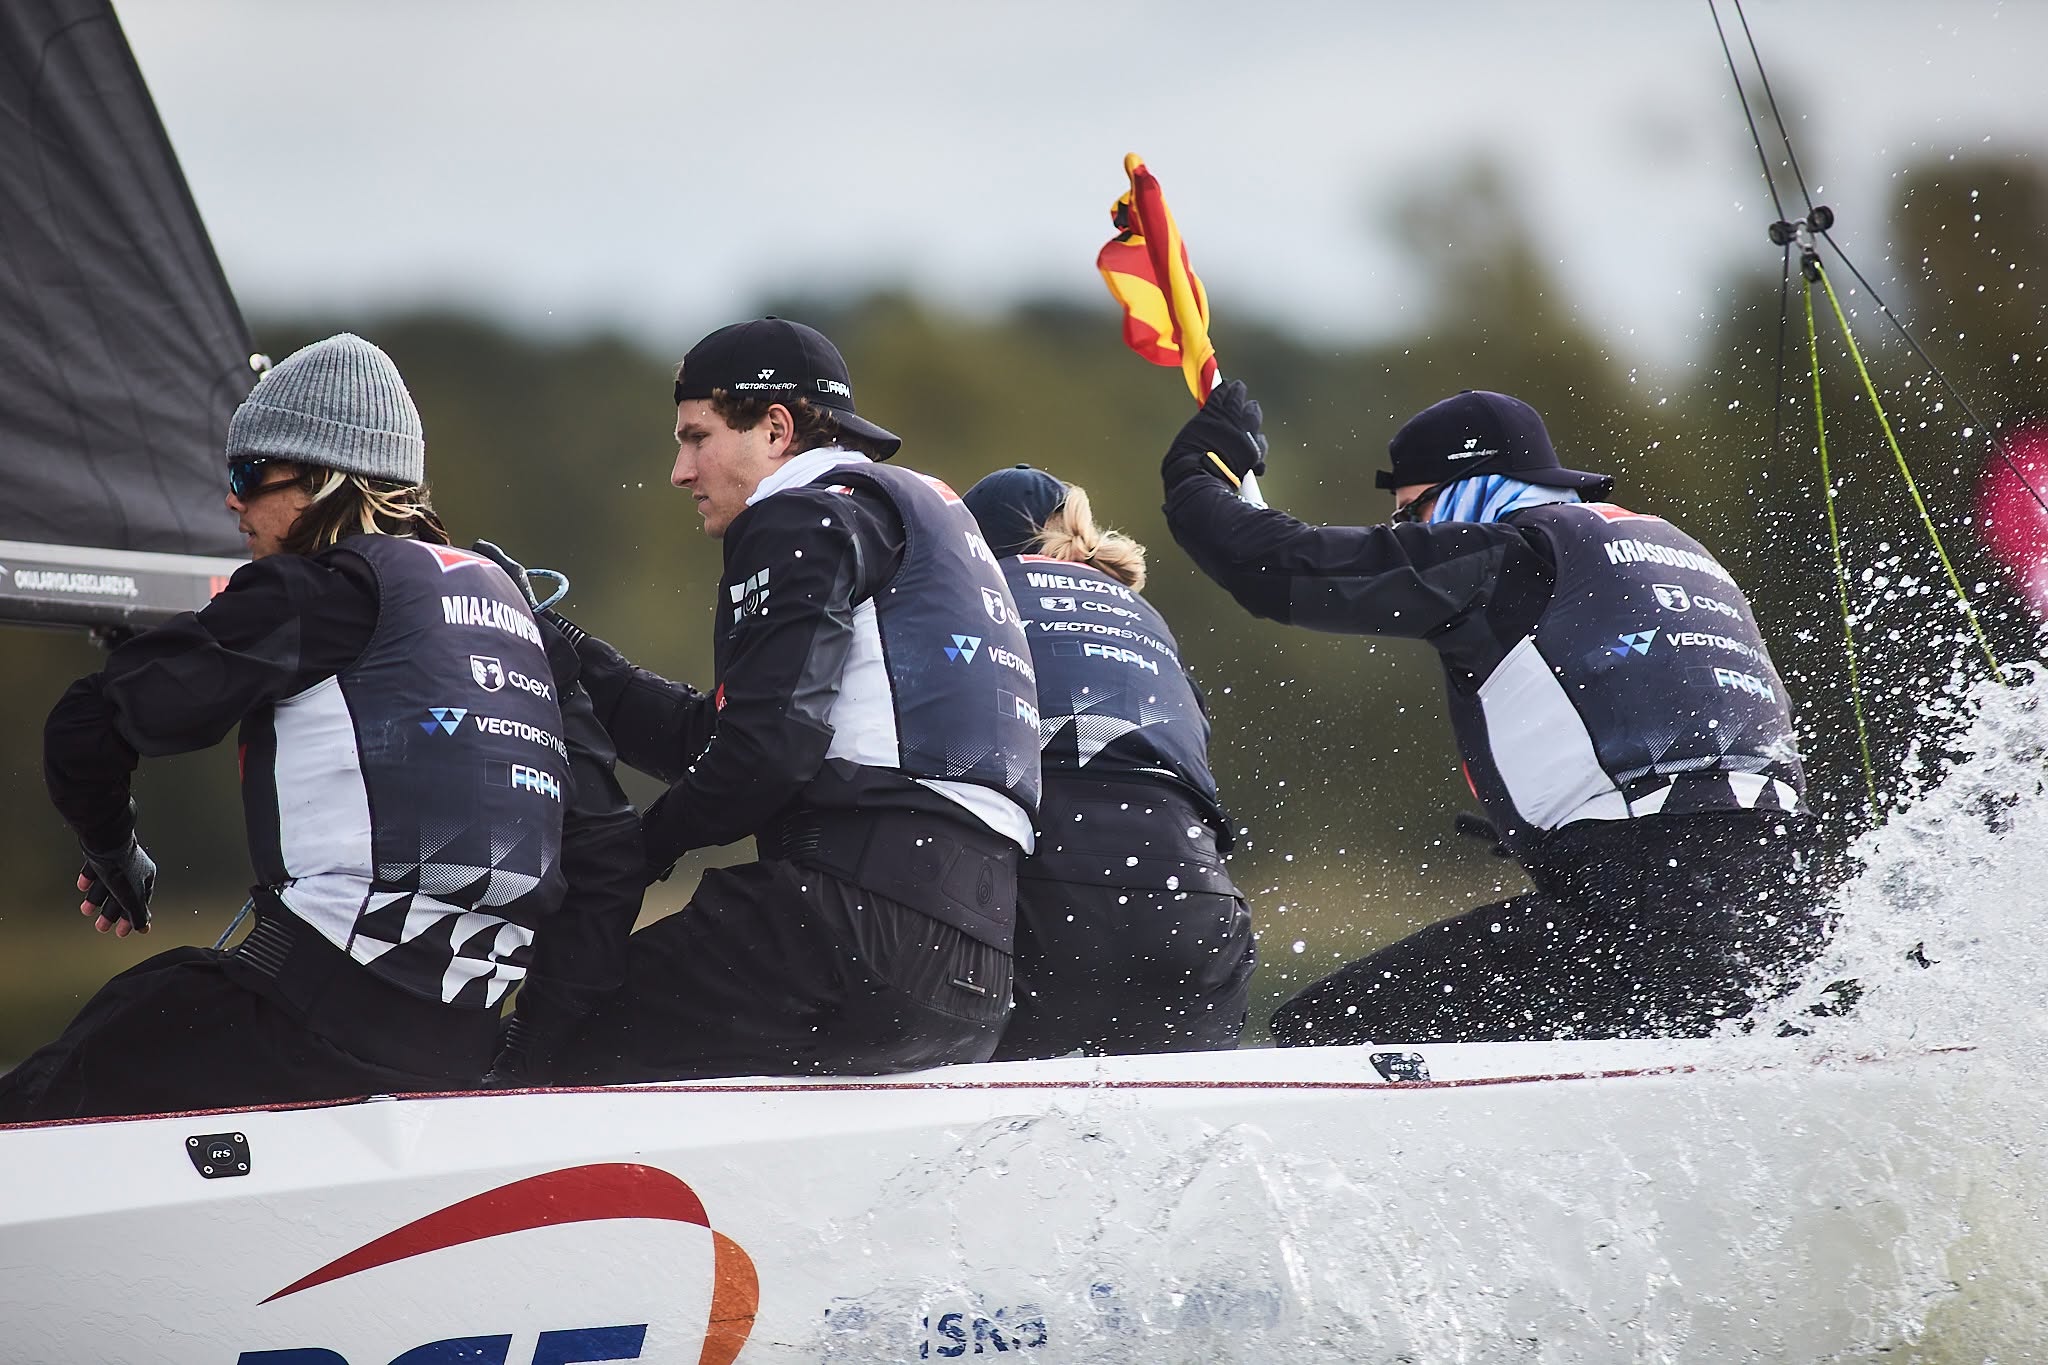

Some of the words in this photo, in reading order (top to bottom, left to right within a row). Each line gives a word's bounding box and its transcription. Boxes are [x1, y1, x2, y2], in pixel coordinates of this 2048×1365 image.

[1026, 572, 1136, 603] WIELCZYK
[1082, 642, 1160, 676] FRPH
[1713, 667, 1777, 704] FRPH
[511, 763, 562, 803] FRPH
[212, 1149, 231, 1159] RS
